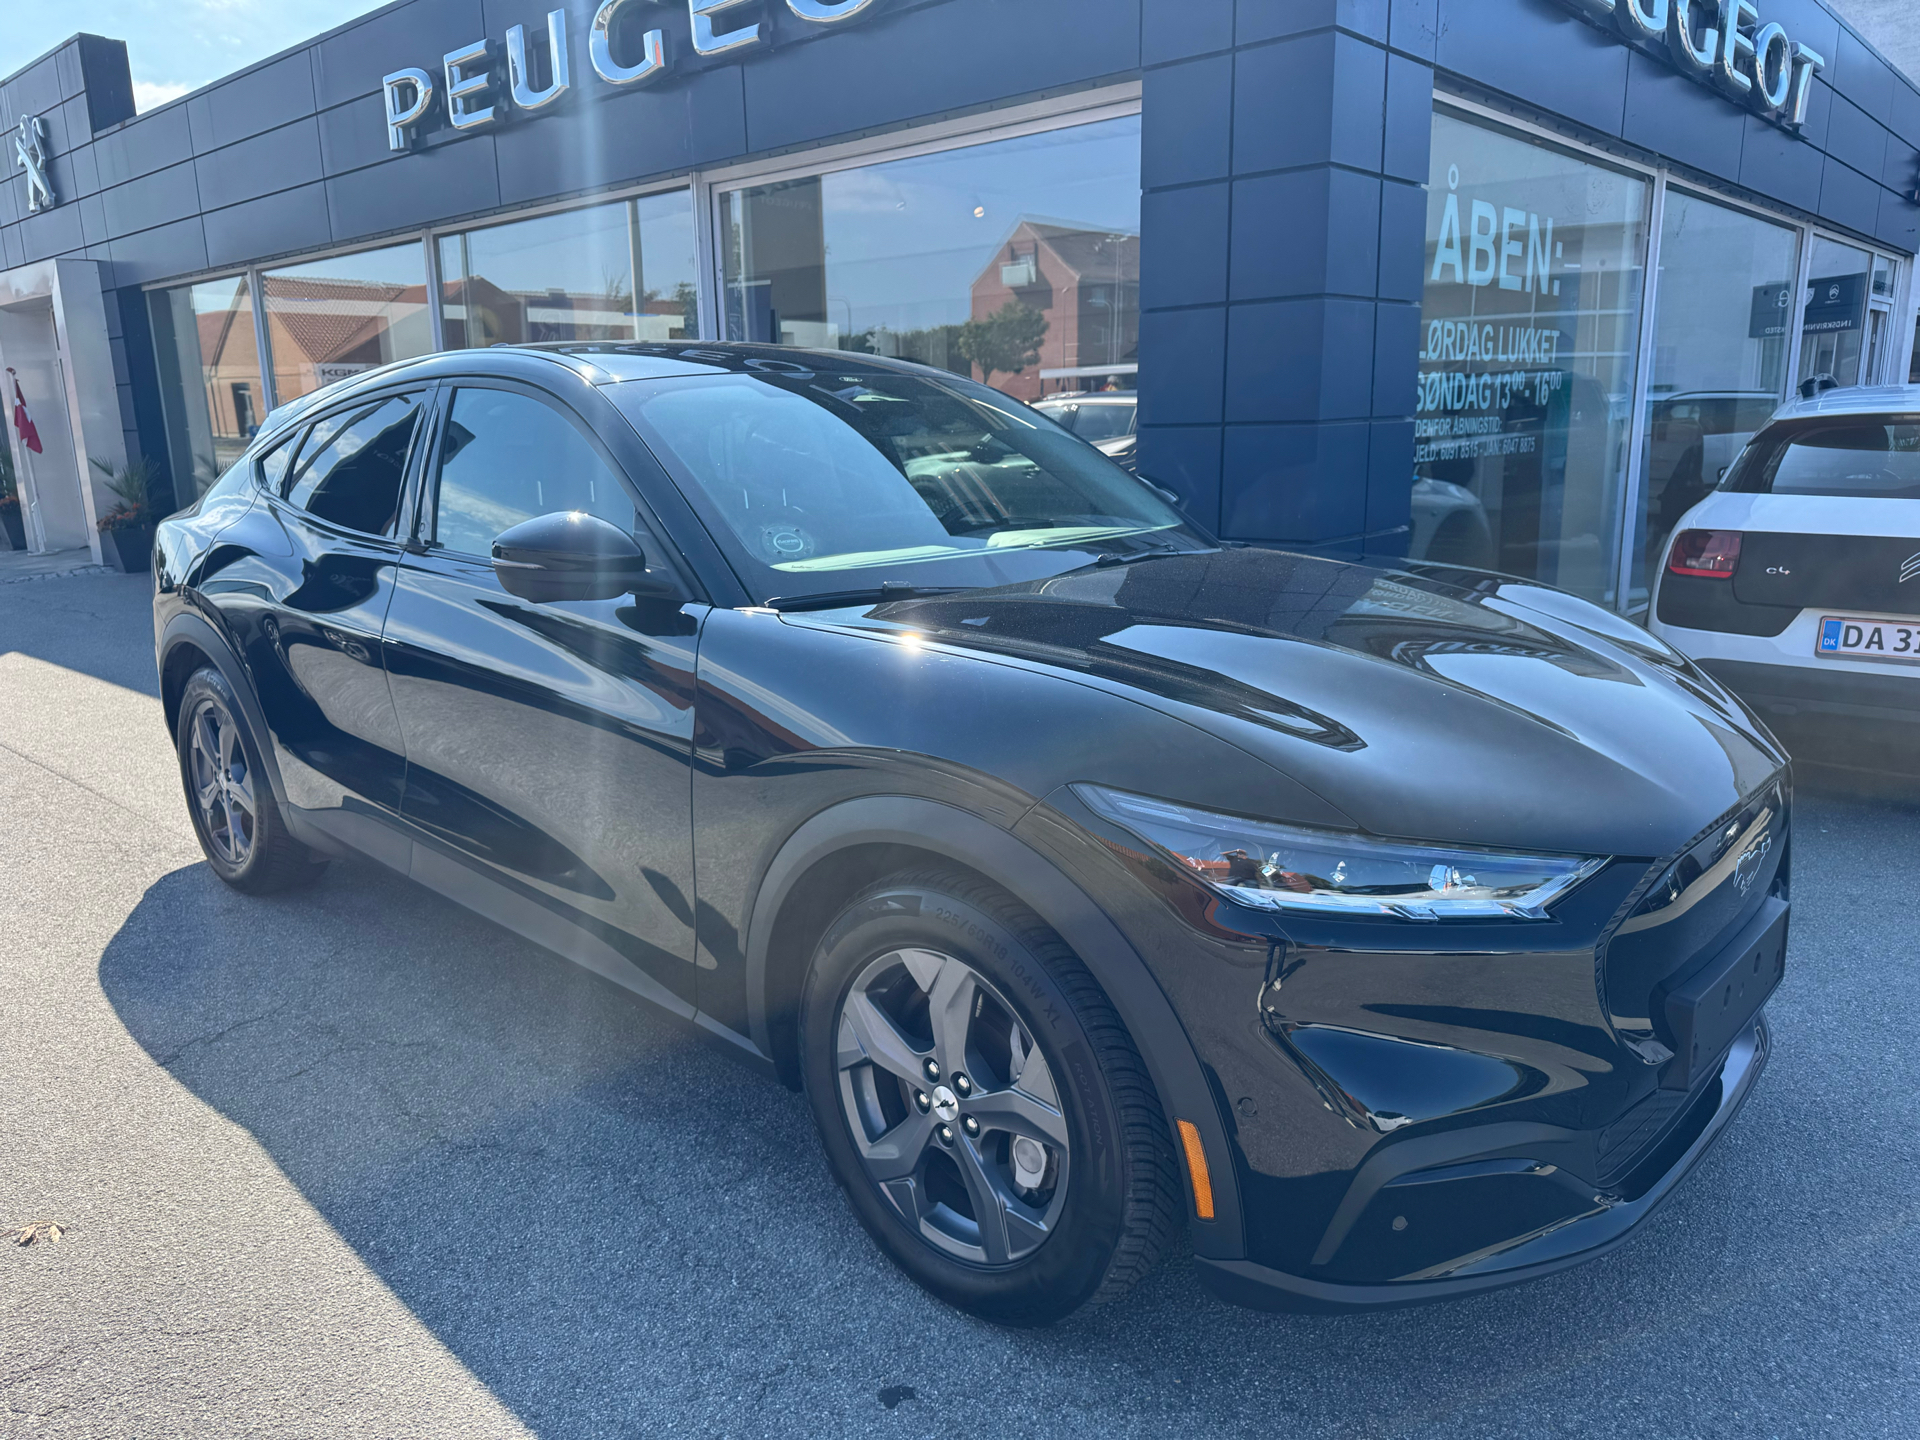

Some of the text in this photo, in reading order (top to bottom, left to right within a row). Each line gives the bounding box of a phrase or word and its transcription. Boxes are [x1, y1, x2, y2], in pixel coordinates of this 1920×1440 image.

[382, 0, 875, 151] PEUGE
[1430, 162, 1564, 297] ÅBEN:
[1498, 326, 1560, 364] LUKKET
[1414, 418, 1452, 438] DENFOR
[1413, 442, 1439, 463] JELD:
[1823, 638, 1837, 646] DK
[1842, 624, 1884, 650] DA
[1010, 960, 1047, 1000] 104W
[1042, 1002, 1061, 1030] XL
